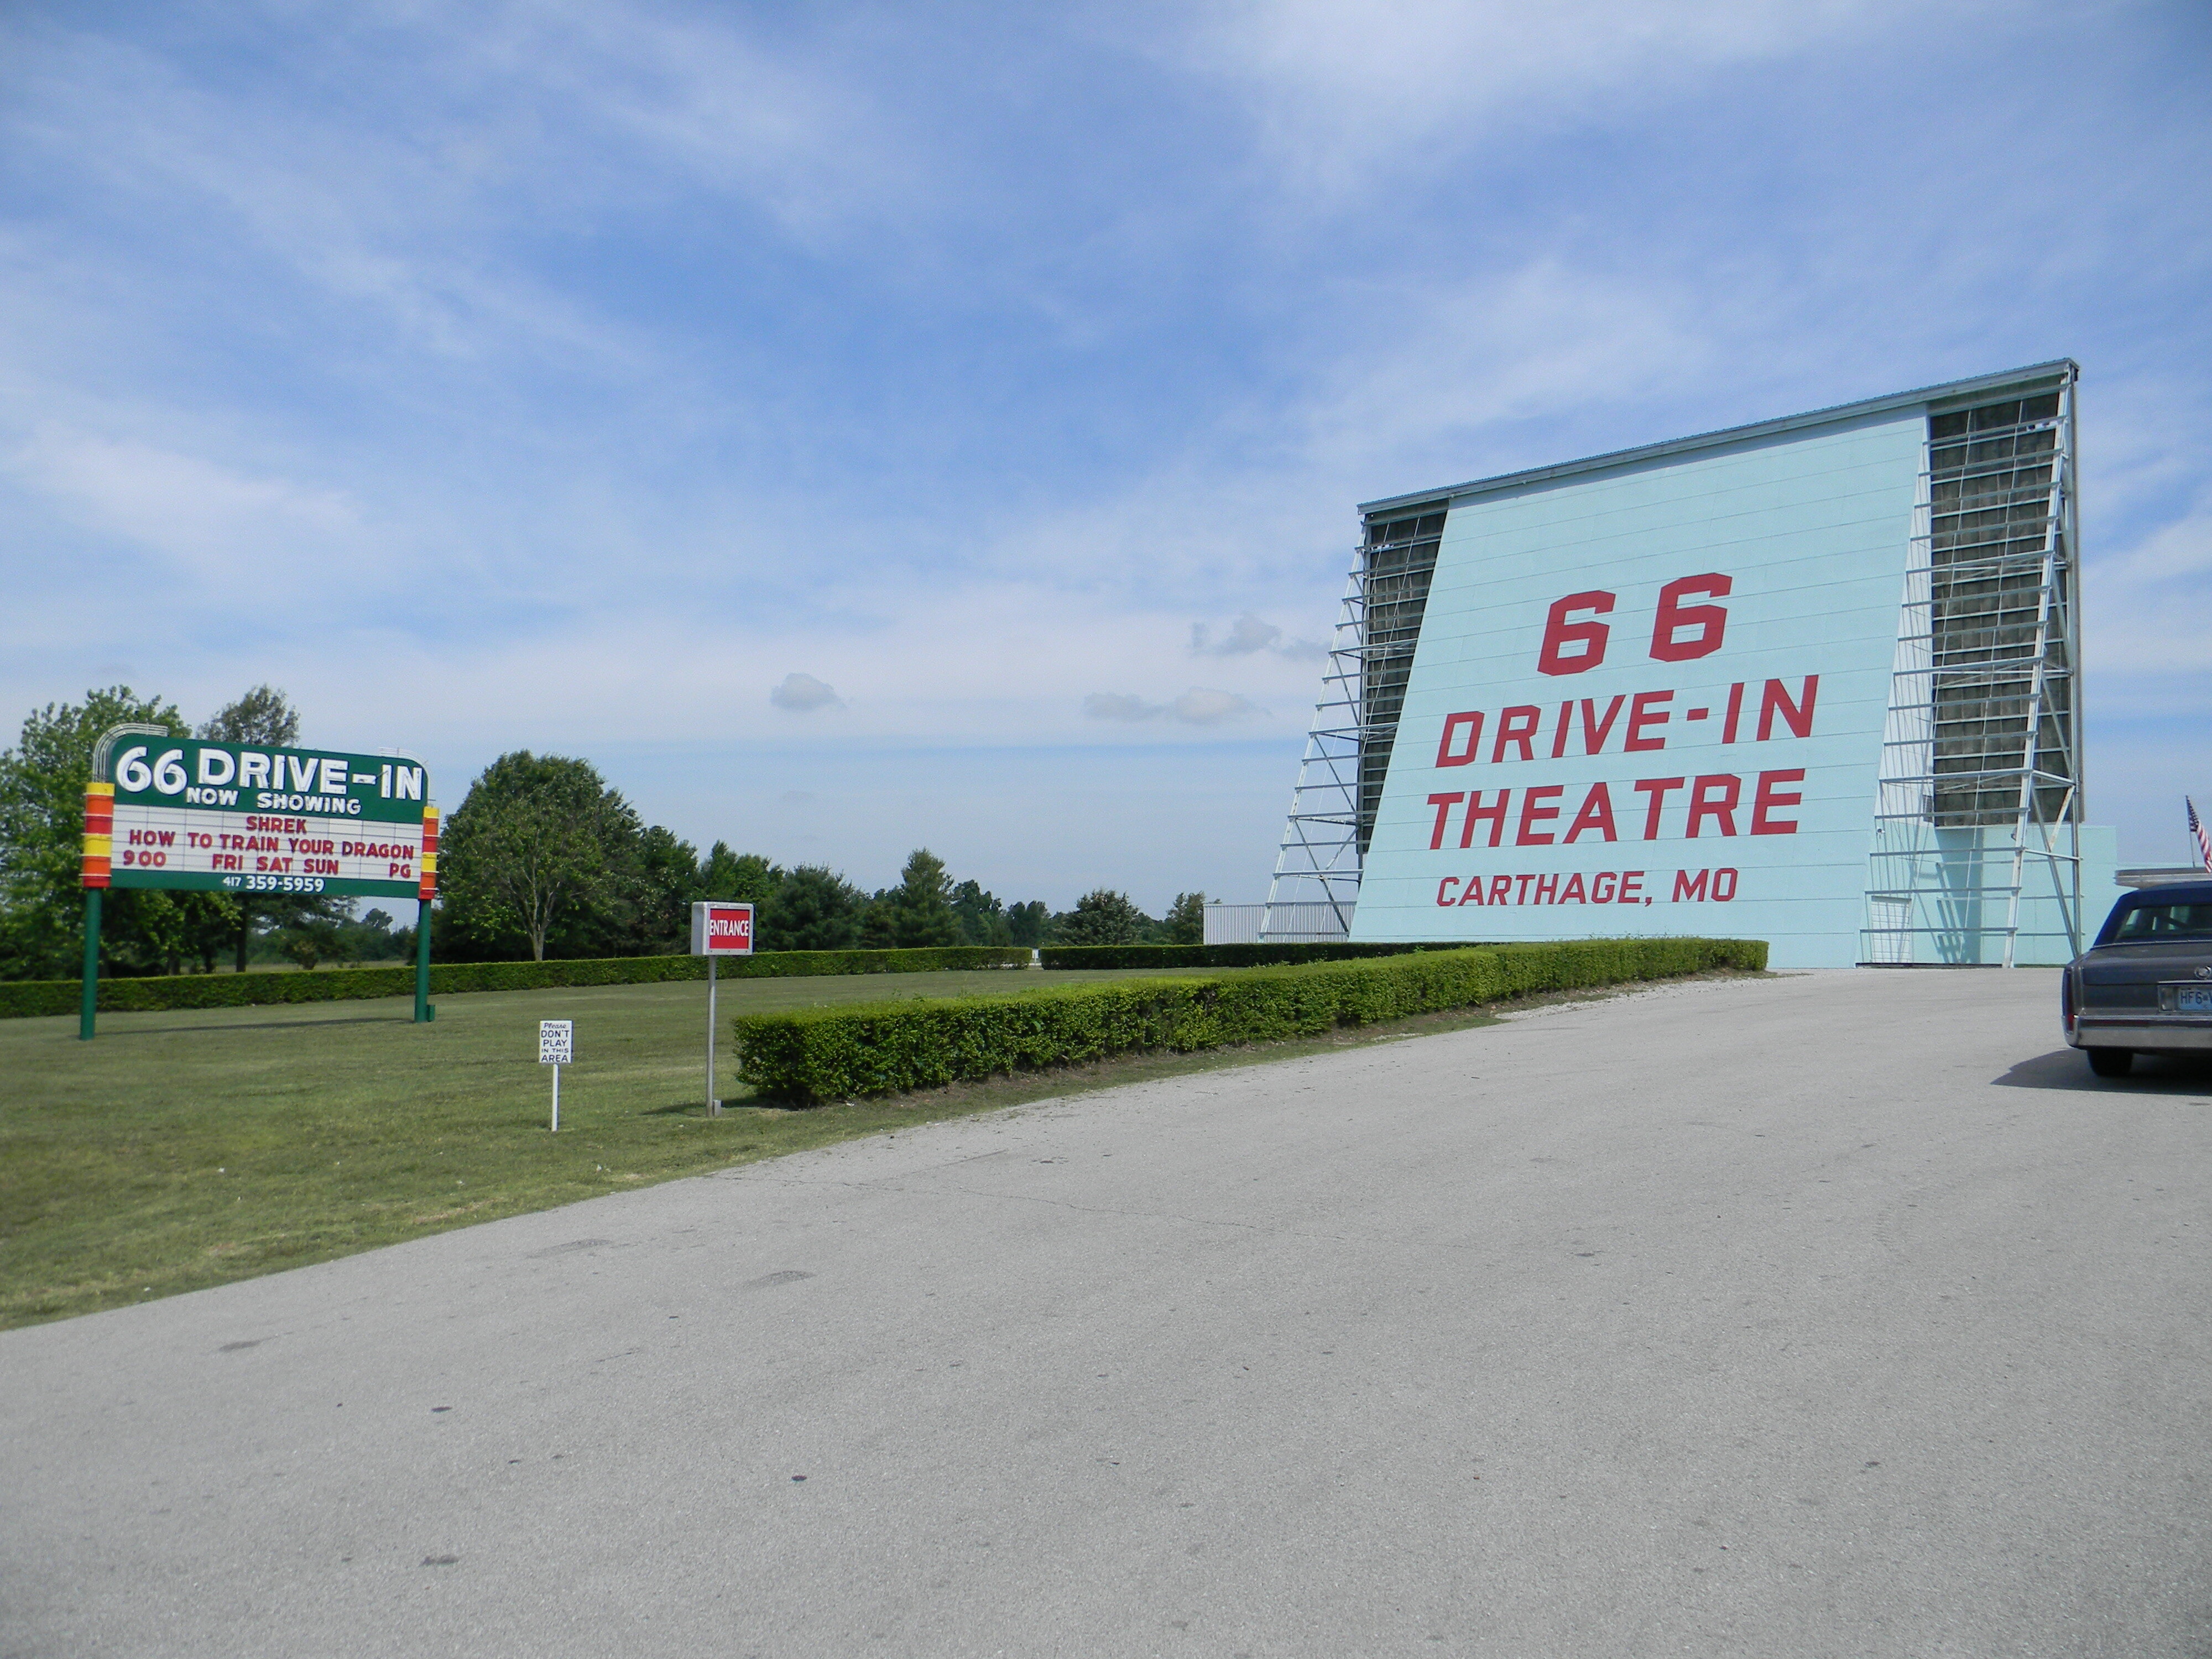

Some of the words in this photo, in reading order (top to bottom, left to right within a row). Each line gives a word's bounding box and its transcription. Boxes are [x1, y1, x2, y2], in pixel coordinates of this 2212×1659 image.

[1435, 675, 1819, 768] DRIVE-IN
[117, 746, 187, 795] 66
[198, 748, 422, 801] DRIVE-IN
[186, 787, 238, 806] NOW
[257, 792, 361, 815] SHOWING
[1427, 769, 1805, 850] THEATRE
[246, 816, 307, 834] SHREK
[129, 829, 175, 847] HOW
[187, 832, 212, 849] TO
[220, 834, 279, 852] TRAIN
[289, 838, 334, 855] YOUR
[342, 841, 414, 859] DRAGON
[123, 850, 166, 867] 900
[212, 853, 243, 870] FRI
[257, 856, 293, 873] SAT
[304, 858, 339, 875] SUN
[389, 863, 411, 878] PG
[223, 876, 241, 887] 417
[246, 875, 325, 893] 359-5959
[1436, 871, 1652, 907] CARTHAGE,
[1672, 868, 1739, 903] MO
[709, 920, 749, 936] ENTRANCE
